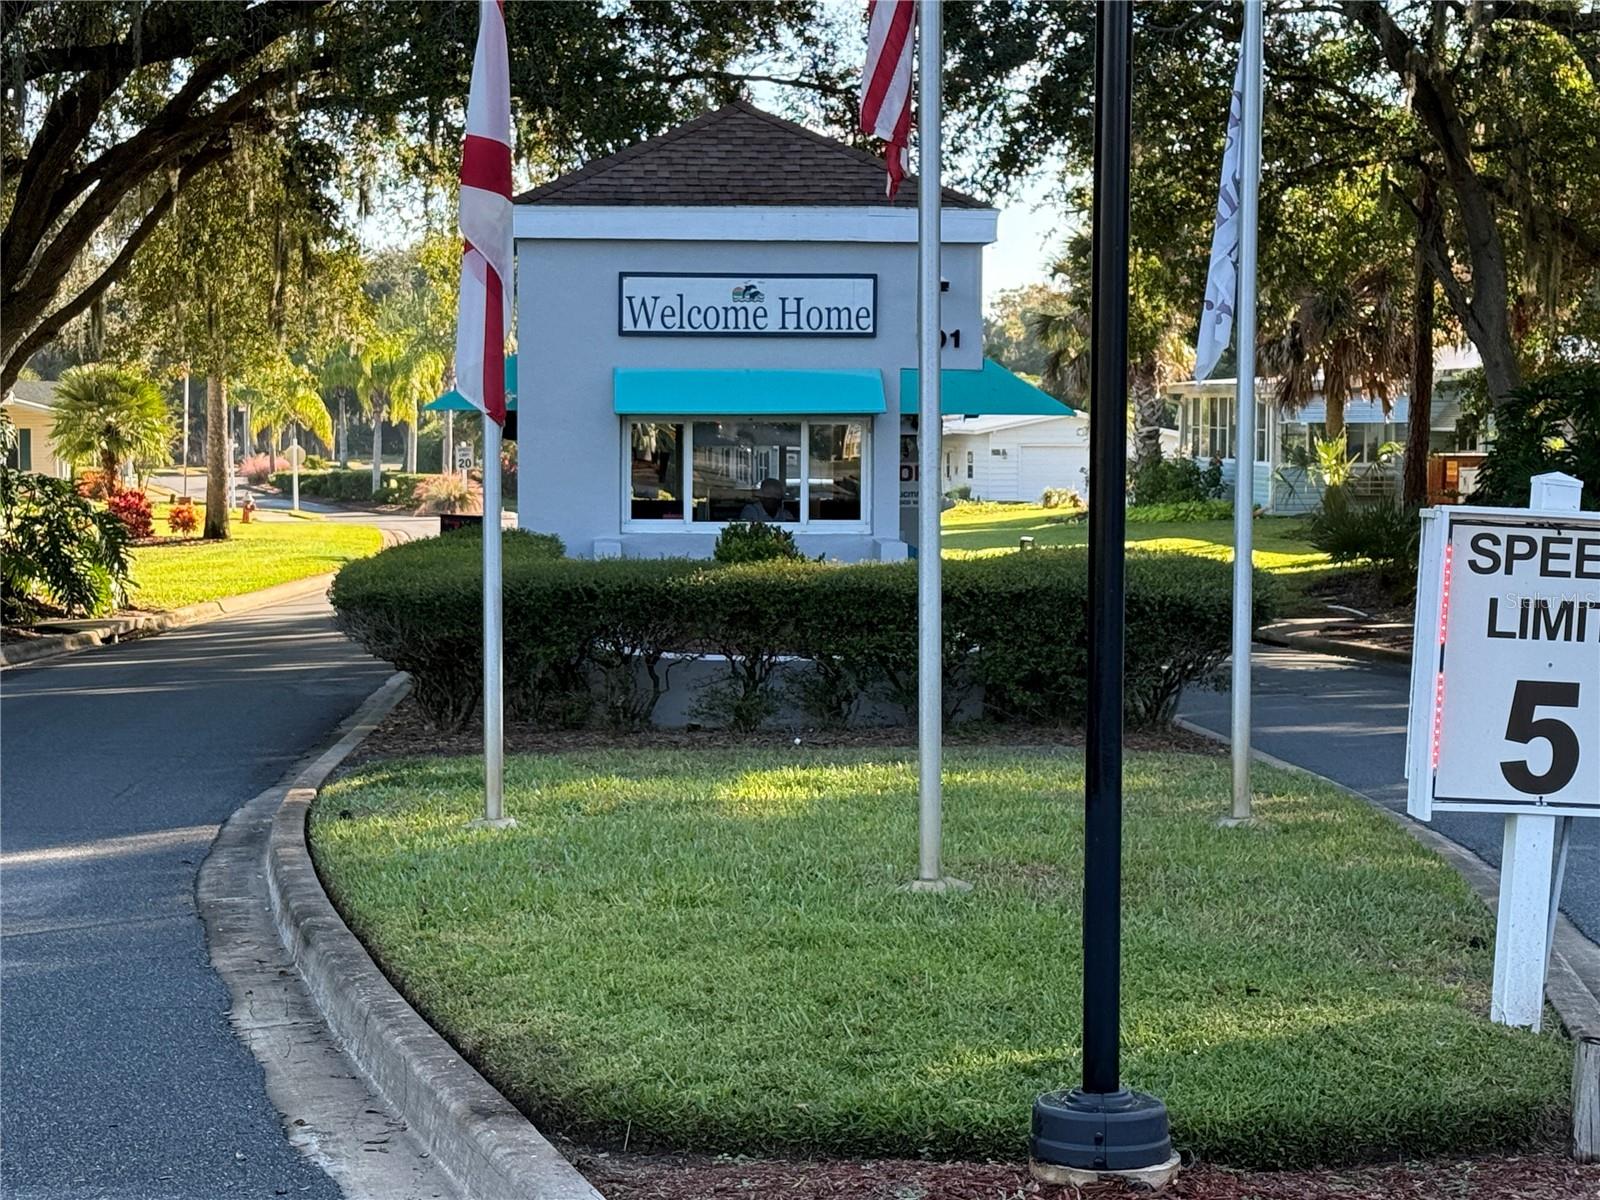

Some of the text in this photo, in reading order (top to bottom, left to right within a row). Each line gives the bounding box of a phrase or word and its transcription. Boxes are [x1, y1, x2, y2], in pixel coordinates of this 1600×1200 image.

[625, 293, 871, 331] Welcome Home
[458, 458, 471, 468] 20
[1500, 679, 1580, 795] 5
